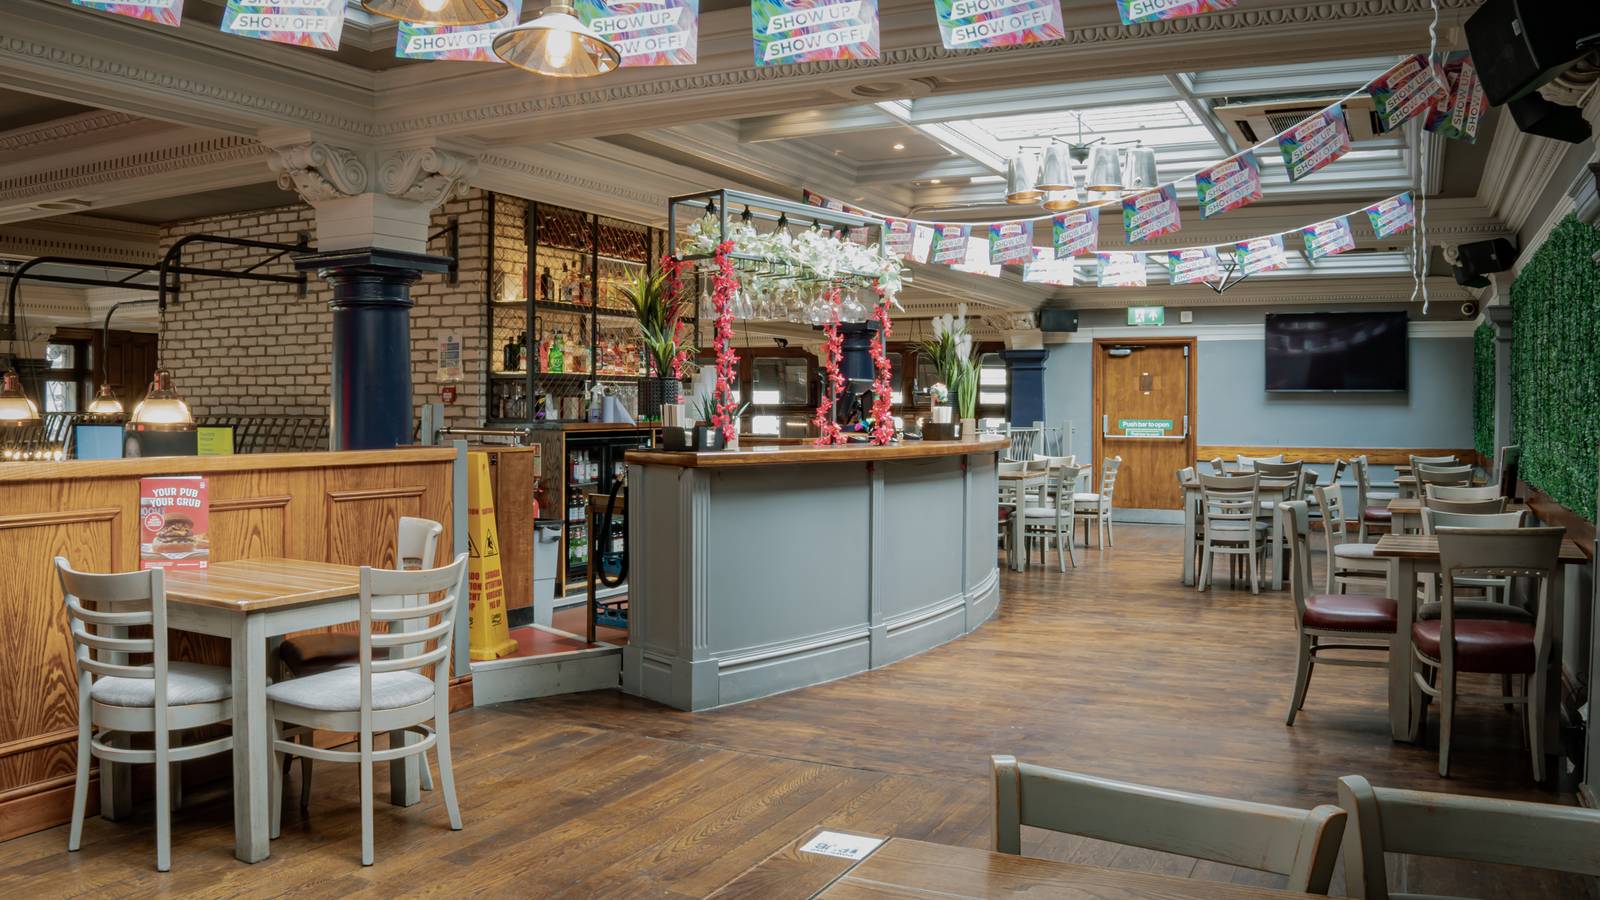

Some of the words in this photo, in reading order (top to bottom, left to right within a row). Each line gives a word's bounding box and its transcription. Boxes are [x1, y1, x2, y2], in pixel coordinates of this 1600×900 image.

[239, 15, 288, 29] SHOW
[592, 15, 646, 33] SHOW
[772, 7, 825, 31] SHOW
[955, 19, 1005, 41] SHOW
[1009, 10, 1048, 29] OFF!
[412, 34, 461, 50] SHOW
[465, 31, 497, 44] OFF
[614, 41, 642, 54] OW
[645, 35, 681, 50] OFF!
[769, 34, 822, 56] SHOW
[826, 27, 865, 44] OFF!
[1387, 82, 1415, 109] SHOW
[1390, 98, 1419, 125] SHOW
[1453, 94, 1467, 125] SHOW
[1294, 138, 1320, 160] SHOW
[1296, 151, 1323, 175] SHOW
[1208, 180, 1234, 198] SHOW
[1208, 195, 1233, 212] SHOW
[1132, 210, 1154, 225] SHOW
[1132, 224, 1155, 239] SHOW
[152, 487, 176, 498] YOUR
[179, 487, 199, 498] PUB
[150, 497, 174, 507] YOUR
[176, 497, 201, 508] GRUB
